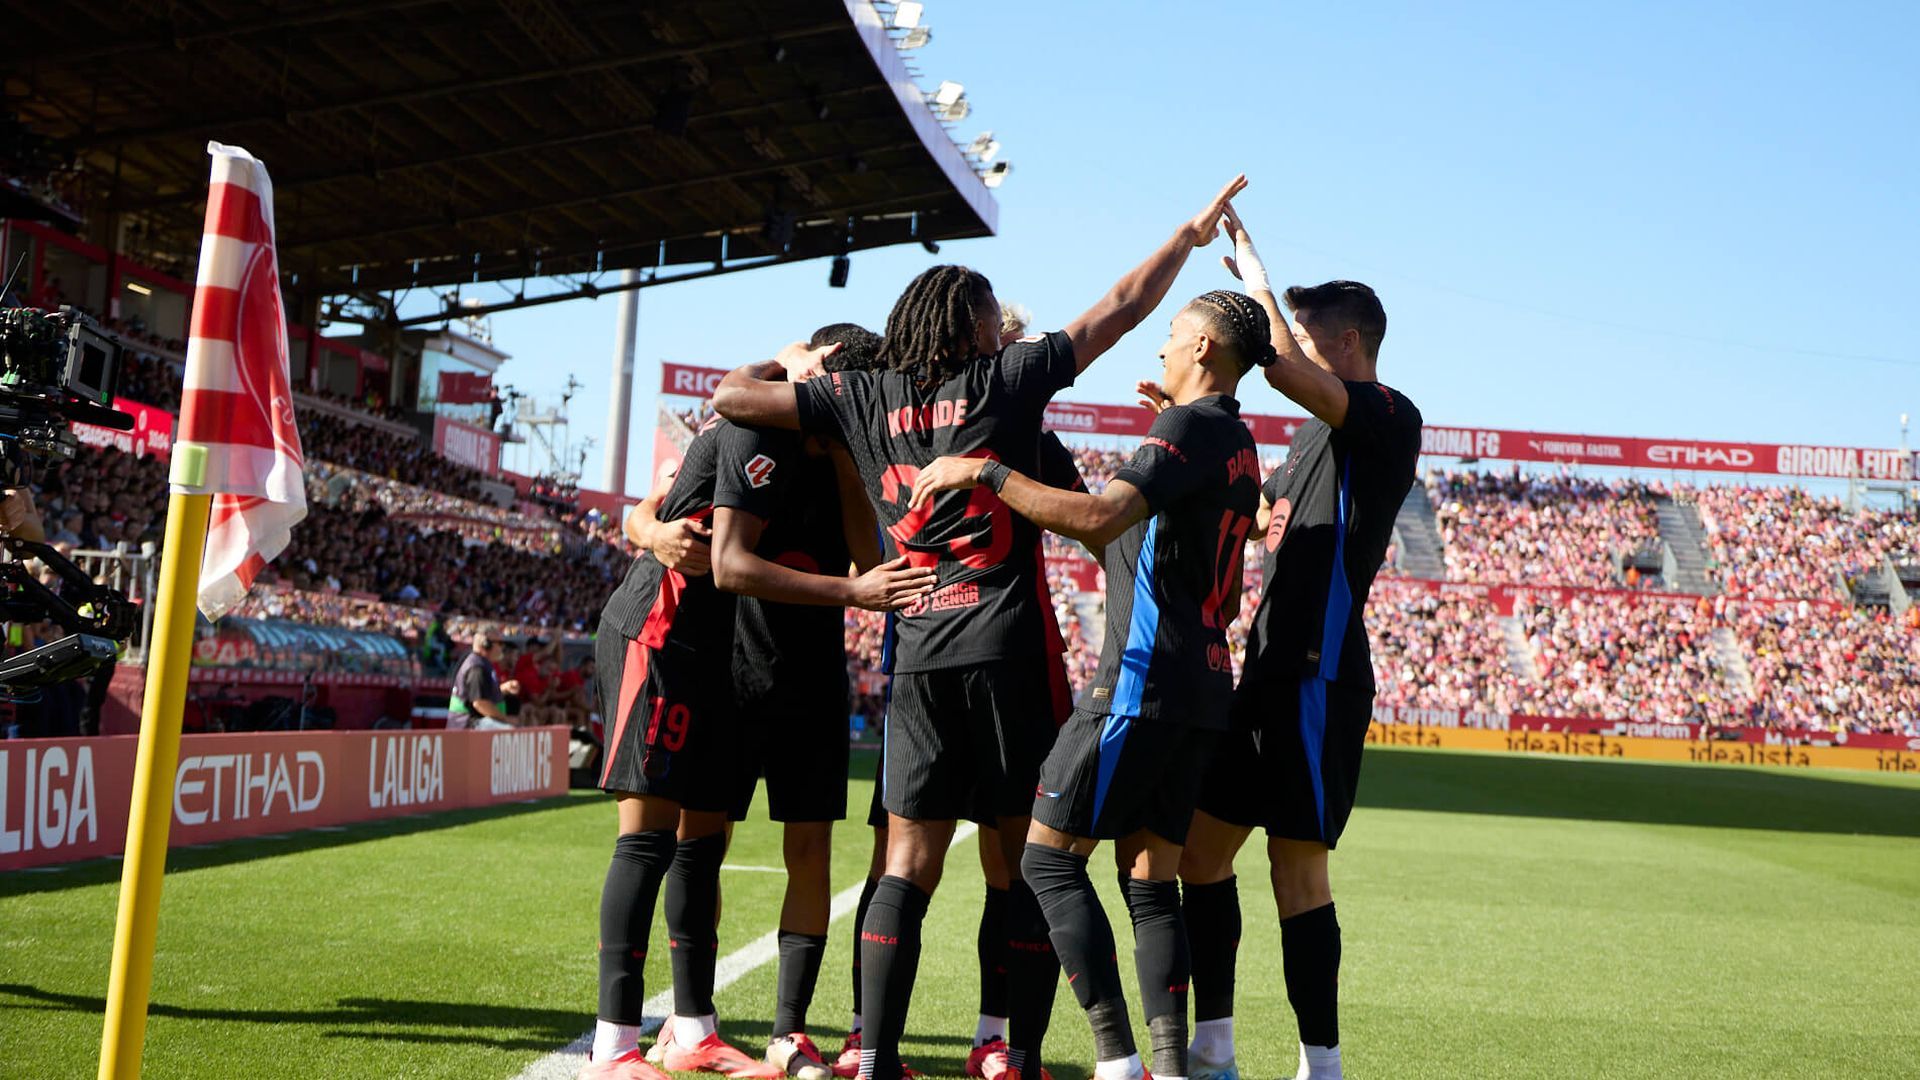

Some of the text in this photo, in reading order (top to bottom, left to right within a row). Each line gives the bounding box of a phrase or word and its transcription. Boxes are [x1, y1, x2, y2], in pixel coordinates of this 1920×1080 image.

[1475, 431, 1500, 457] FC
[1646, 444, 1755, 467] ETIHAD
[1776, 446, 1859, 477] GIRONA
[931, 591, 979, 609] ACNUR
[644, 696, 691, 752] 19
[1505, 731, 1624, 757] idealista
[1689, 740, 1811, 766] idealista
[369, 735, 444, 808] LALIGA
[490, 731, 552, 796] GIRONA FC
[174, 750, 326, 825] ETIHAD
